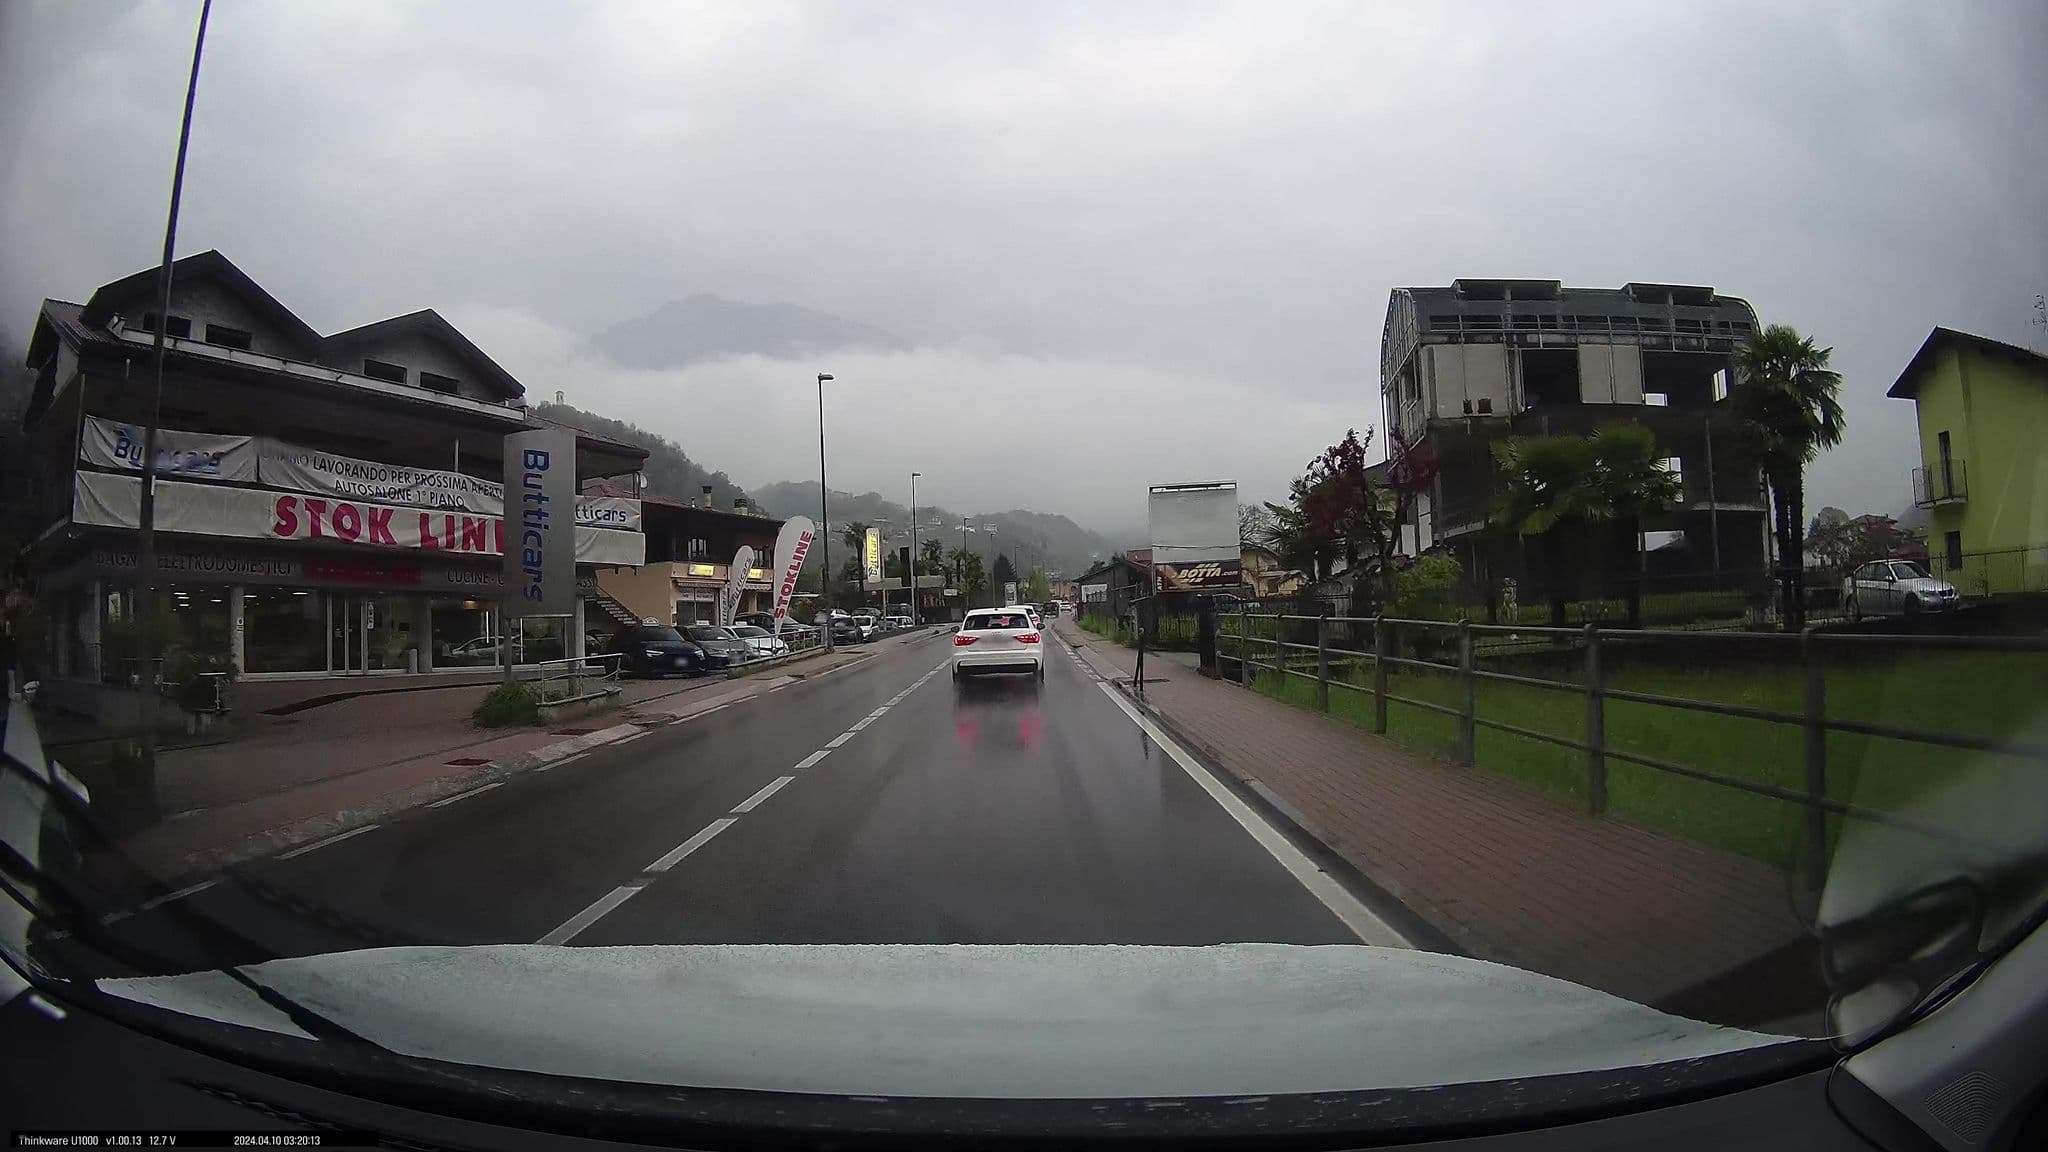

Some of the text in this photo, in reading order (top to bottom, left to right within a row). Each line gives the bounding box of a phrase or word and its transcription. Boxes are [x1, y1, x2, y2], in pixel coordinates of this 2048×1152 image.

[313, 455, 387, 482] LAVORANDO
[391, 470, 411, 484] PER
[414, 472, 468, 492] PROSSIMA
[335, 479, 412, 502] AUTOSALONE
[429, 491, 465, 508] PIANO
[274, 495, 398, 546] STOK
[523, 449, 550, 602] Butticars
[447, 568, 489, 585] CUCINE
[774, 530, 813, 619] STOKLINE
